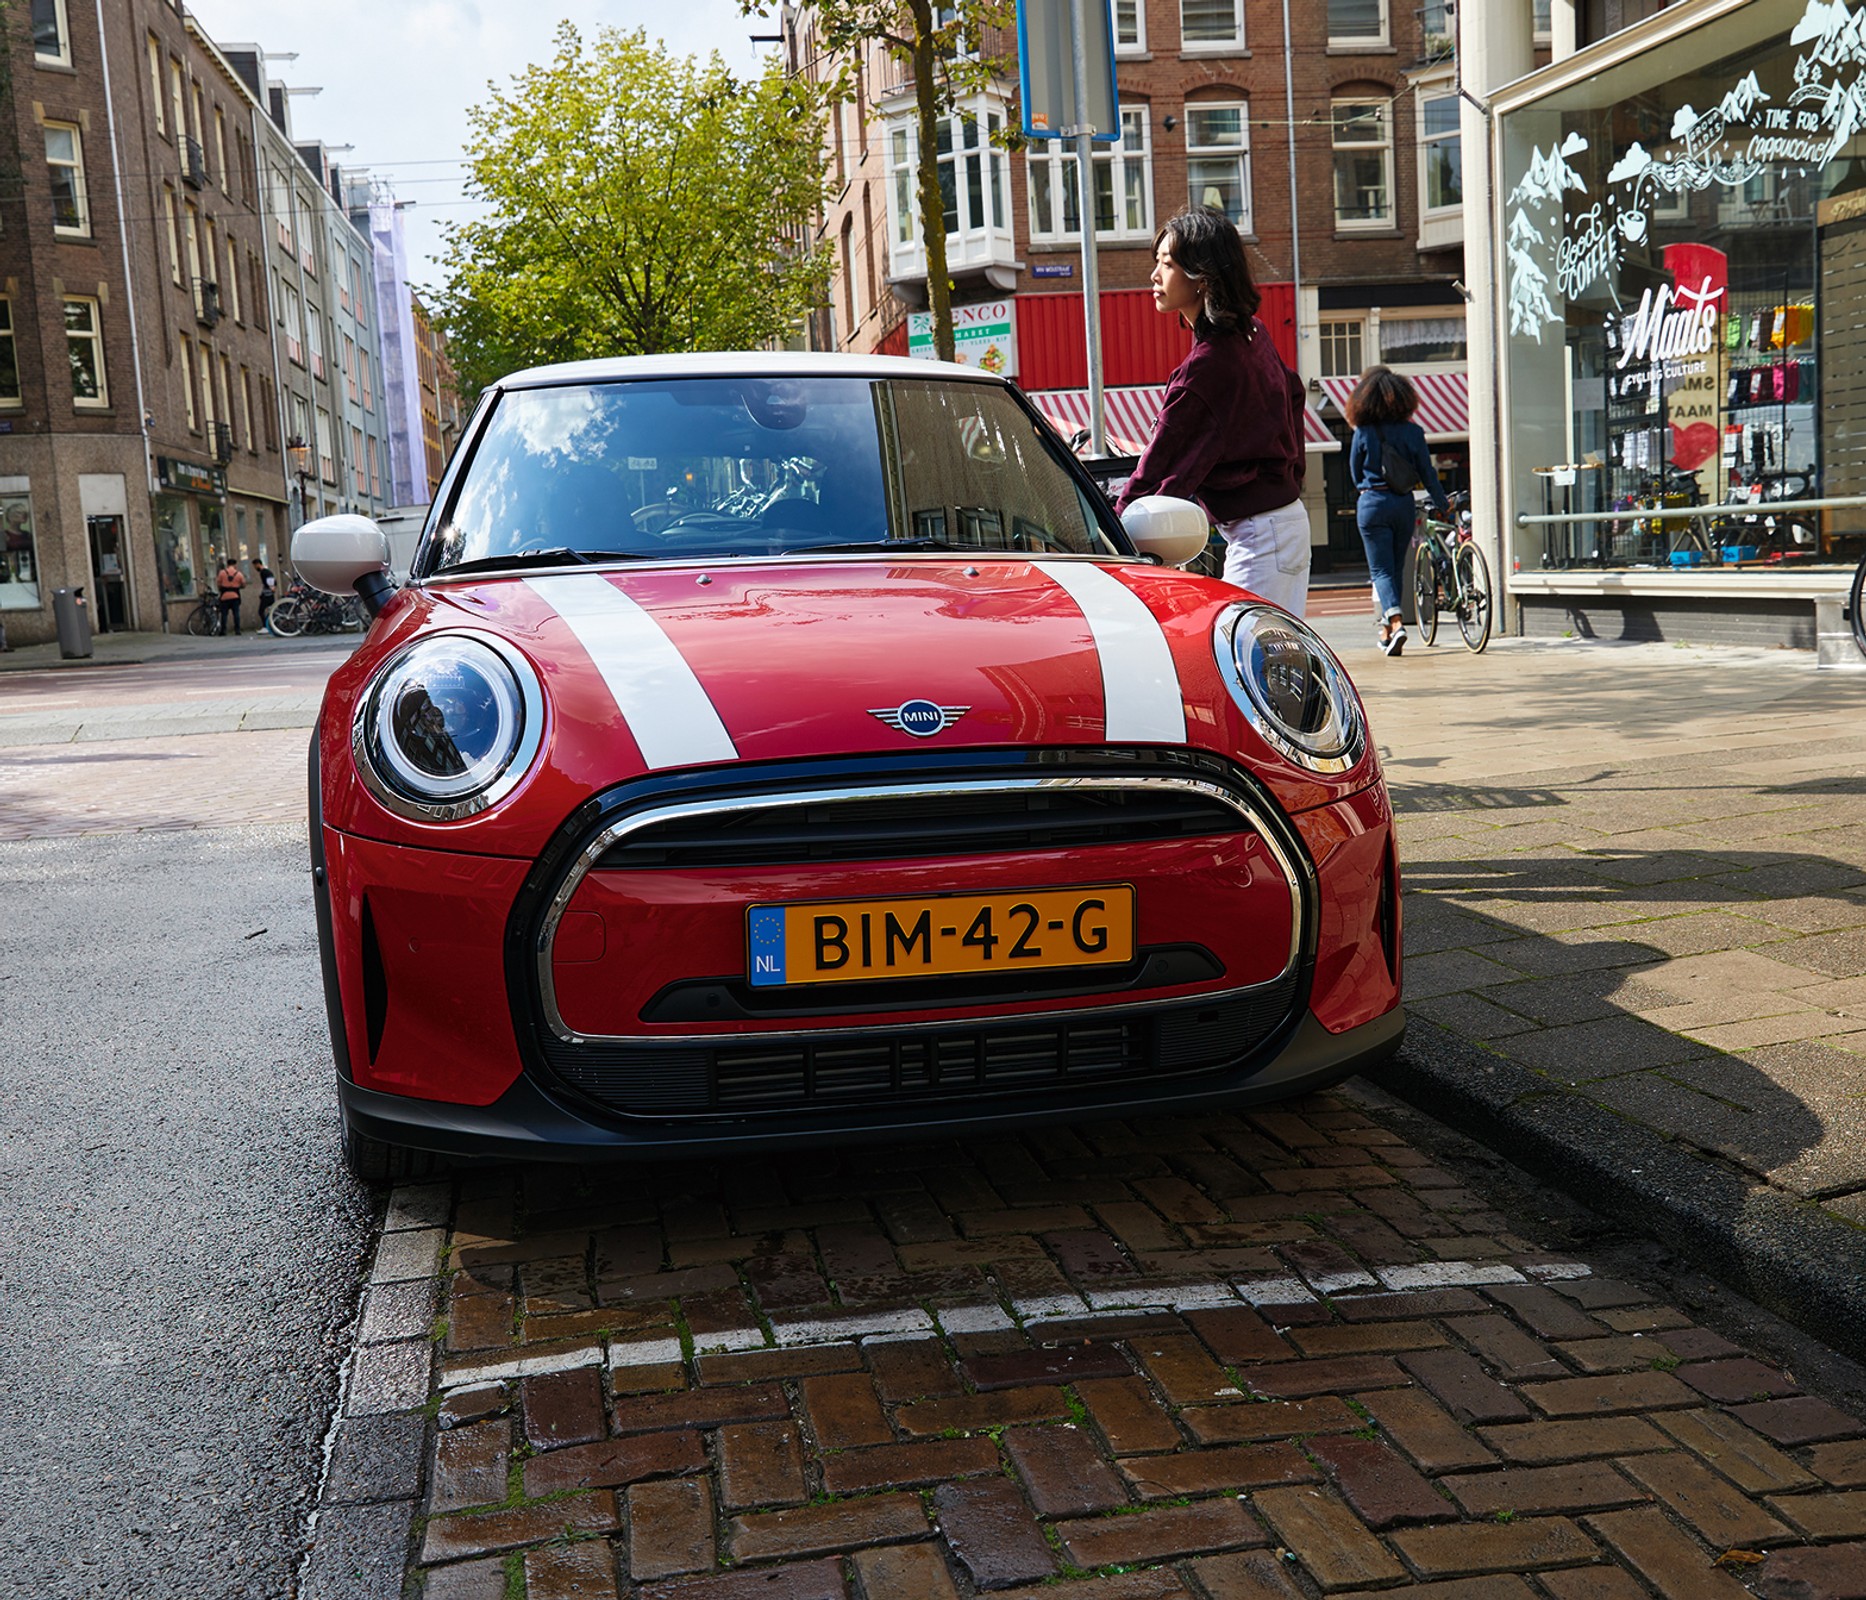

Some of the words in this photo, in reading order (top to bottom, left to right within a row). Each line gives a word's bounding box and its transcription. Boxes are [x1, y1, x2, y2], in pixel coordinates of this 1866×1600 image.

[1765, 108, 1792, 131] TIME
[1795, 111, 1820, 133] FOR
[1556, 202, 1603, 293] Good
[1568, 224, 1617, 301] COFFEE
[1616, 274, 1725, 370] Maats
[1664, 361, 1707, 379] CULTURE
[904, 711, 939, 722] MINI
[813, 898, 1108, 971] BIM-42-G
[756, 955, 781, 973] NL
